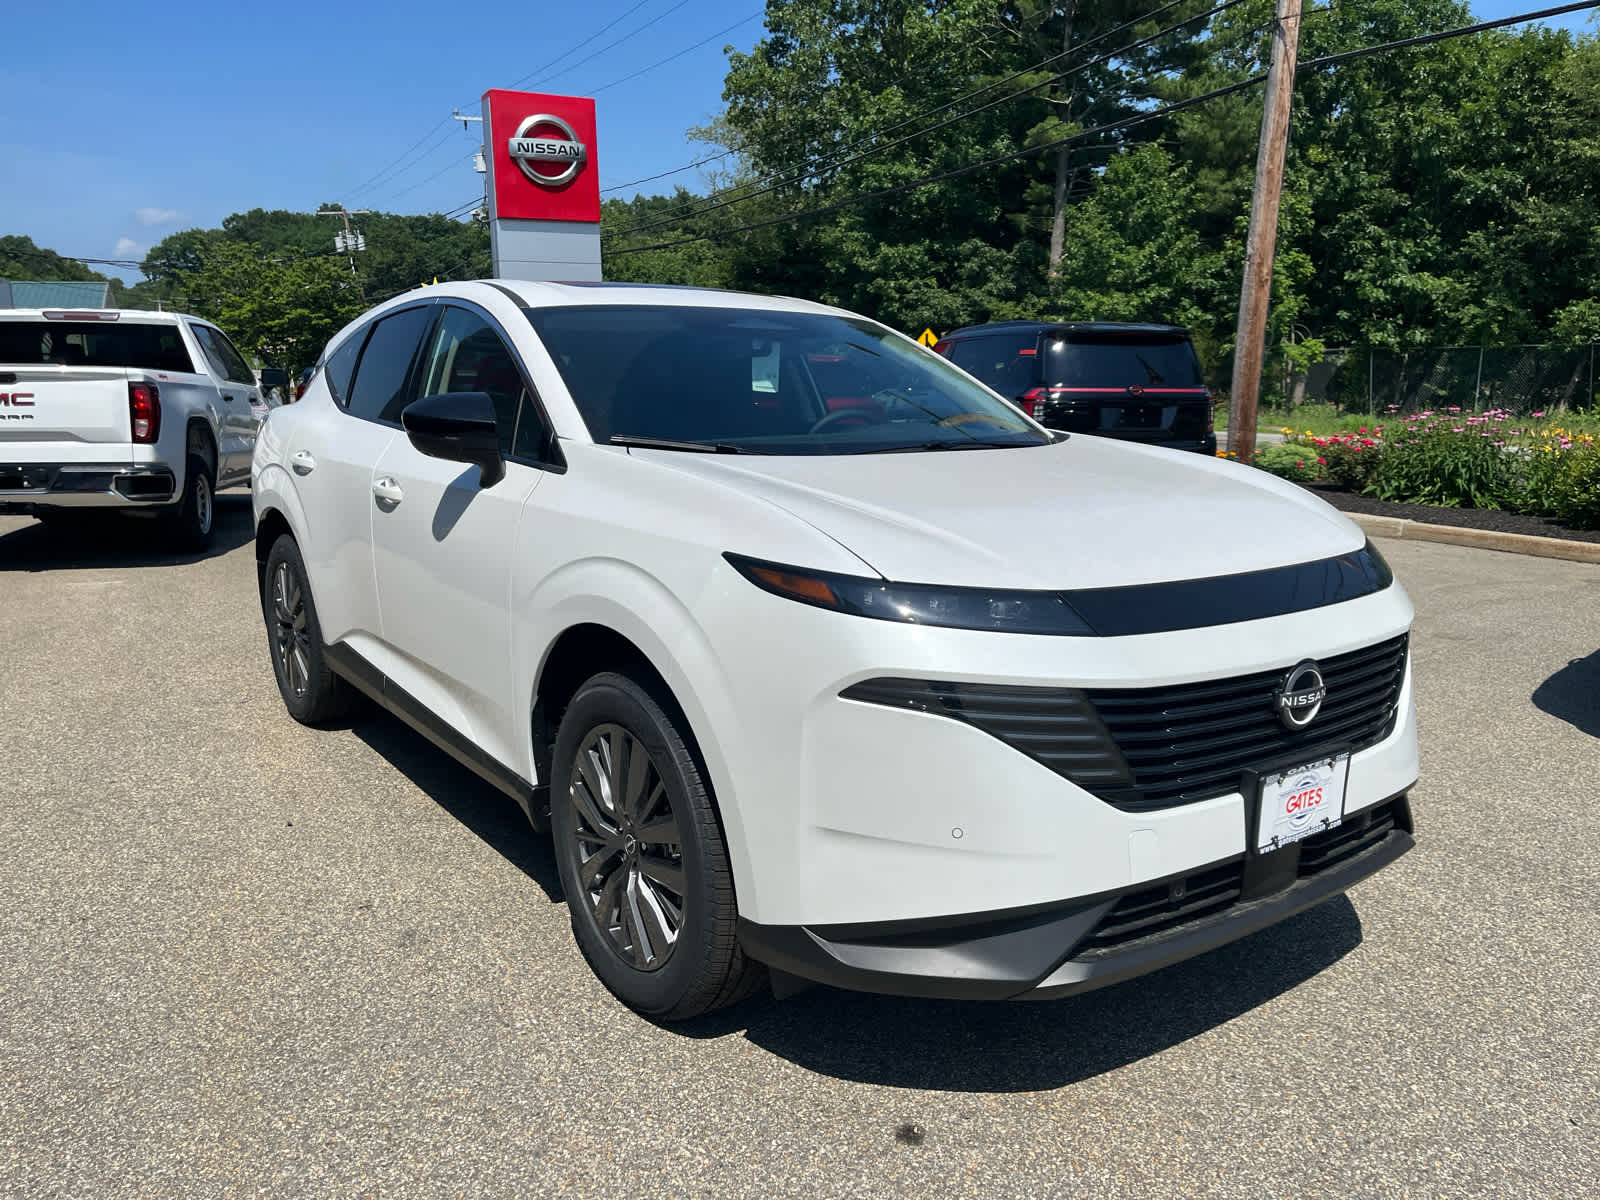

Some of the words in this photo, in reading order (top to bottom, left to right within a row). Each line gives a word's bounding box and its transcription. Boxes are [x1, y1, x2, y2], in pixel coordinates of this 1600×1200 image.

[517, 142, 580, 156] NISSAN
[1281, 687, 1327, 707] NISSAN
[1285, 787, 1324, 814] GATES
